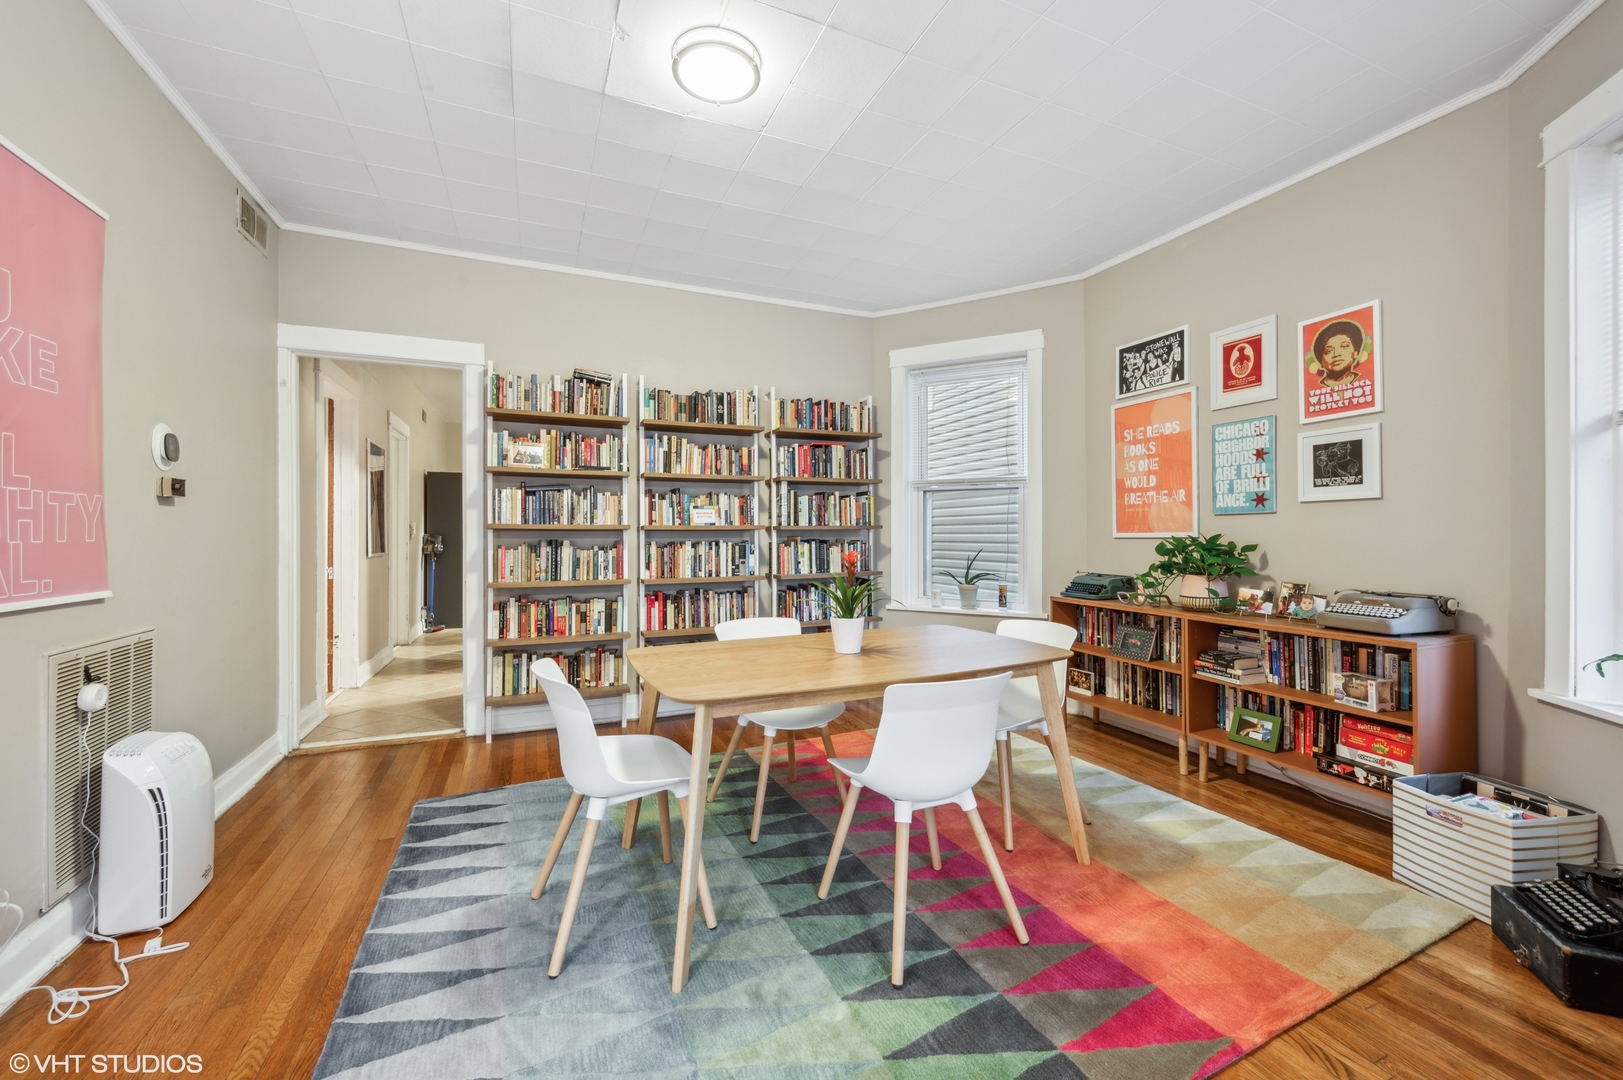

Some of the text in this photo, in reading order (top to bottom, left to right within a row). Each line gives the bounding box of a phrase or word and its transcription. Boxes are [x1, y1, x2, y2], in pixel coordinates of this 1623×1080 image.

[1145, 333, 1181, 353] STONEWALL
[1153, 346, 1168, 356] WAS
[1162, 353, 1168, 361] A
[1144, 367, 1169, 380] POLICE
[1147, 376, 1164, 387] RIOT
[1308, 378, 1373, 396] YOUR SILENCE
[1308, 385, 1372, 405] WILL NOT
[1308, 395, 1373, 413] PROTECT YOU
[1123, 421, 1180, 442] SHE READS
[1215, 419, 1269, 441] CHICAGO
[1123, 441, 1157, 458] BOOKS
[1215, 435, 1270, 454] NEIGHBOR
[1123, 457, 1159, 473] AS ONE
[1215, 450, 1257, 468] HOODS
[1216, 462, 1269, 481] ARE FULL
[1123, 474, 1157, 489] WOULD
[1215, 477, 1270, 494] OF BRILLI
[1124, 488, 1187, 505] BREATHE AIR
[1216, 493, 1250, 508] ANCE.
